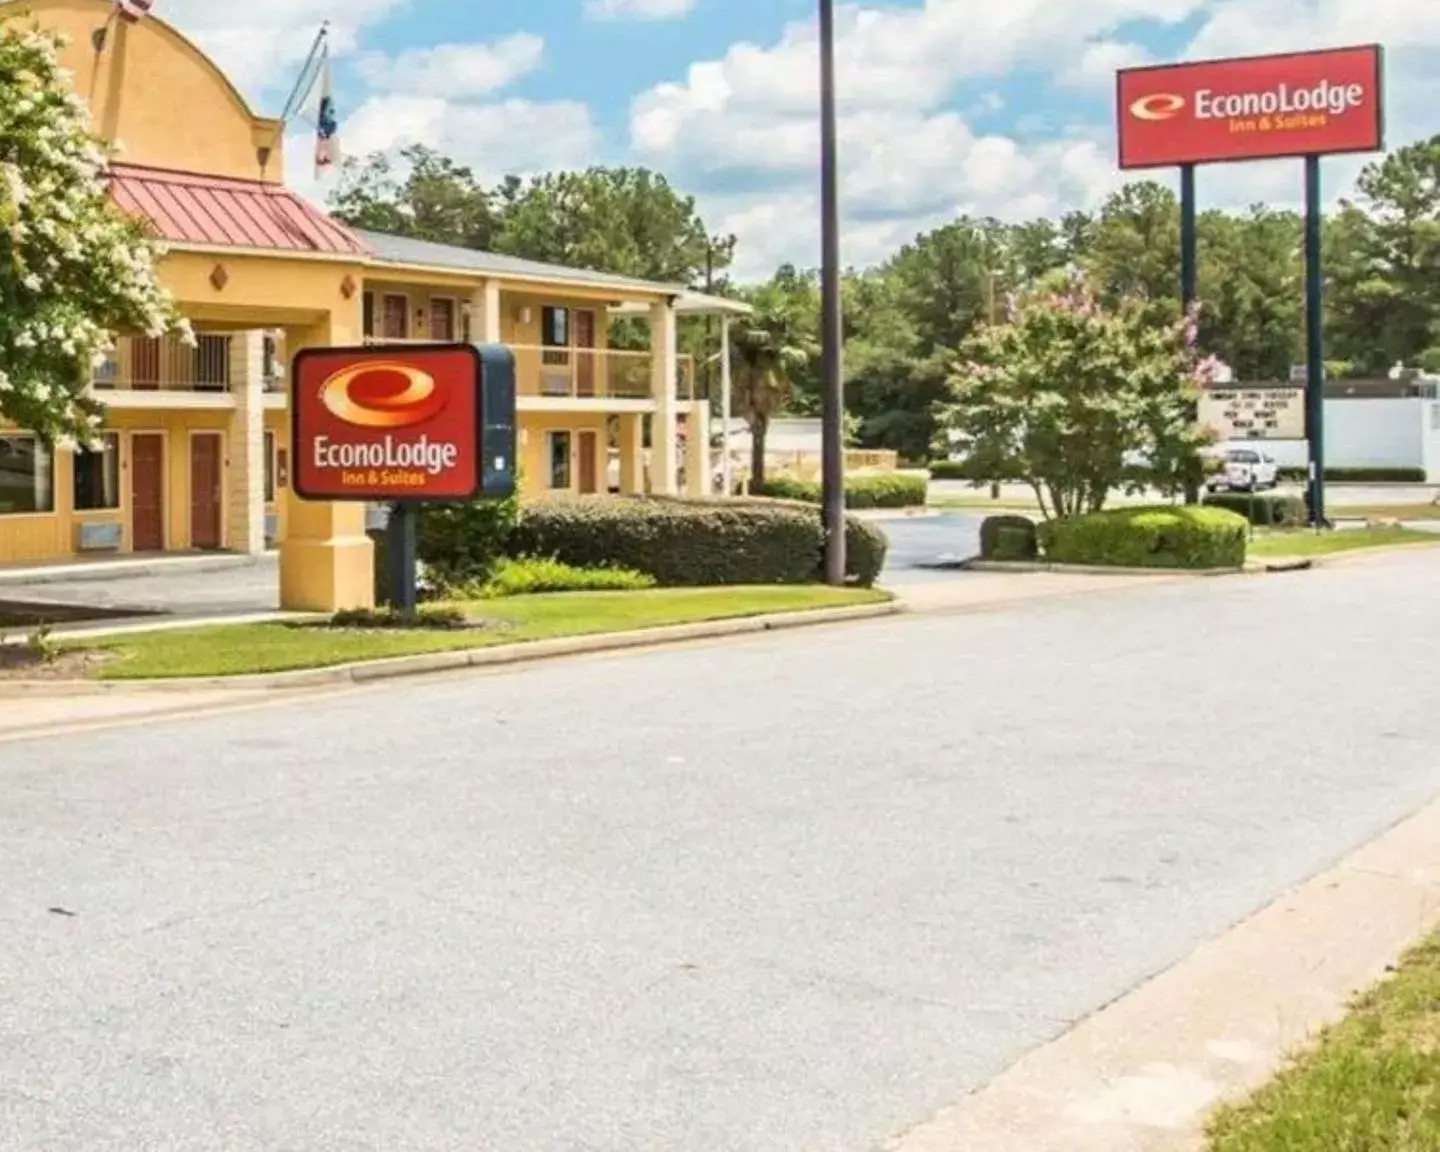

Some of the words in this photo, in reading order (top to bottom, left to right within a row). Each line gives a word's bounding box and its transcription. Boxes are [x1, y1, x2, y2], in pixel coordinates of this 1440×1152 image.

[1194, 79, 1363, 119] EconoLodge
[1229, 119, 1256, 133] Inn
[1259, 116, 1271, 131] &
[1274, 113, 1326, 130] Suites
[313, 434, 457, 474] EconoLodge
[342, 470, 365, 485] Inn
[368, 470, 377, 485] &
[381, 469, 426, 486] Suites
